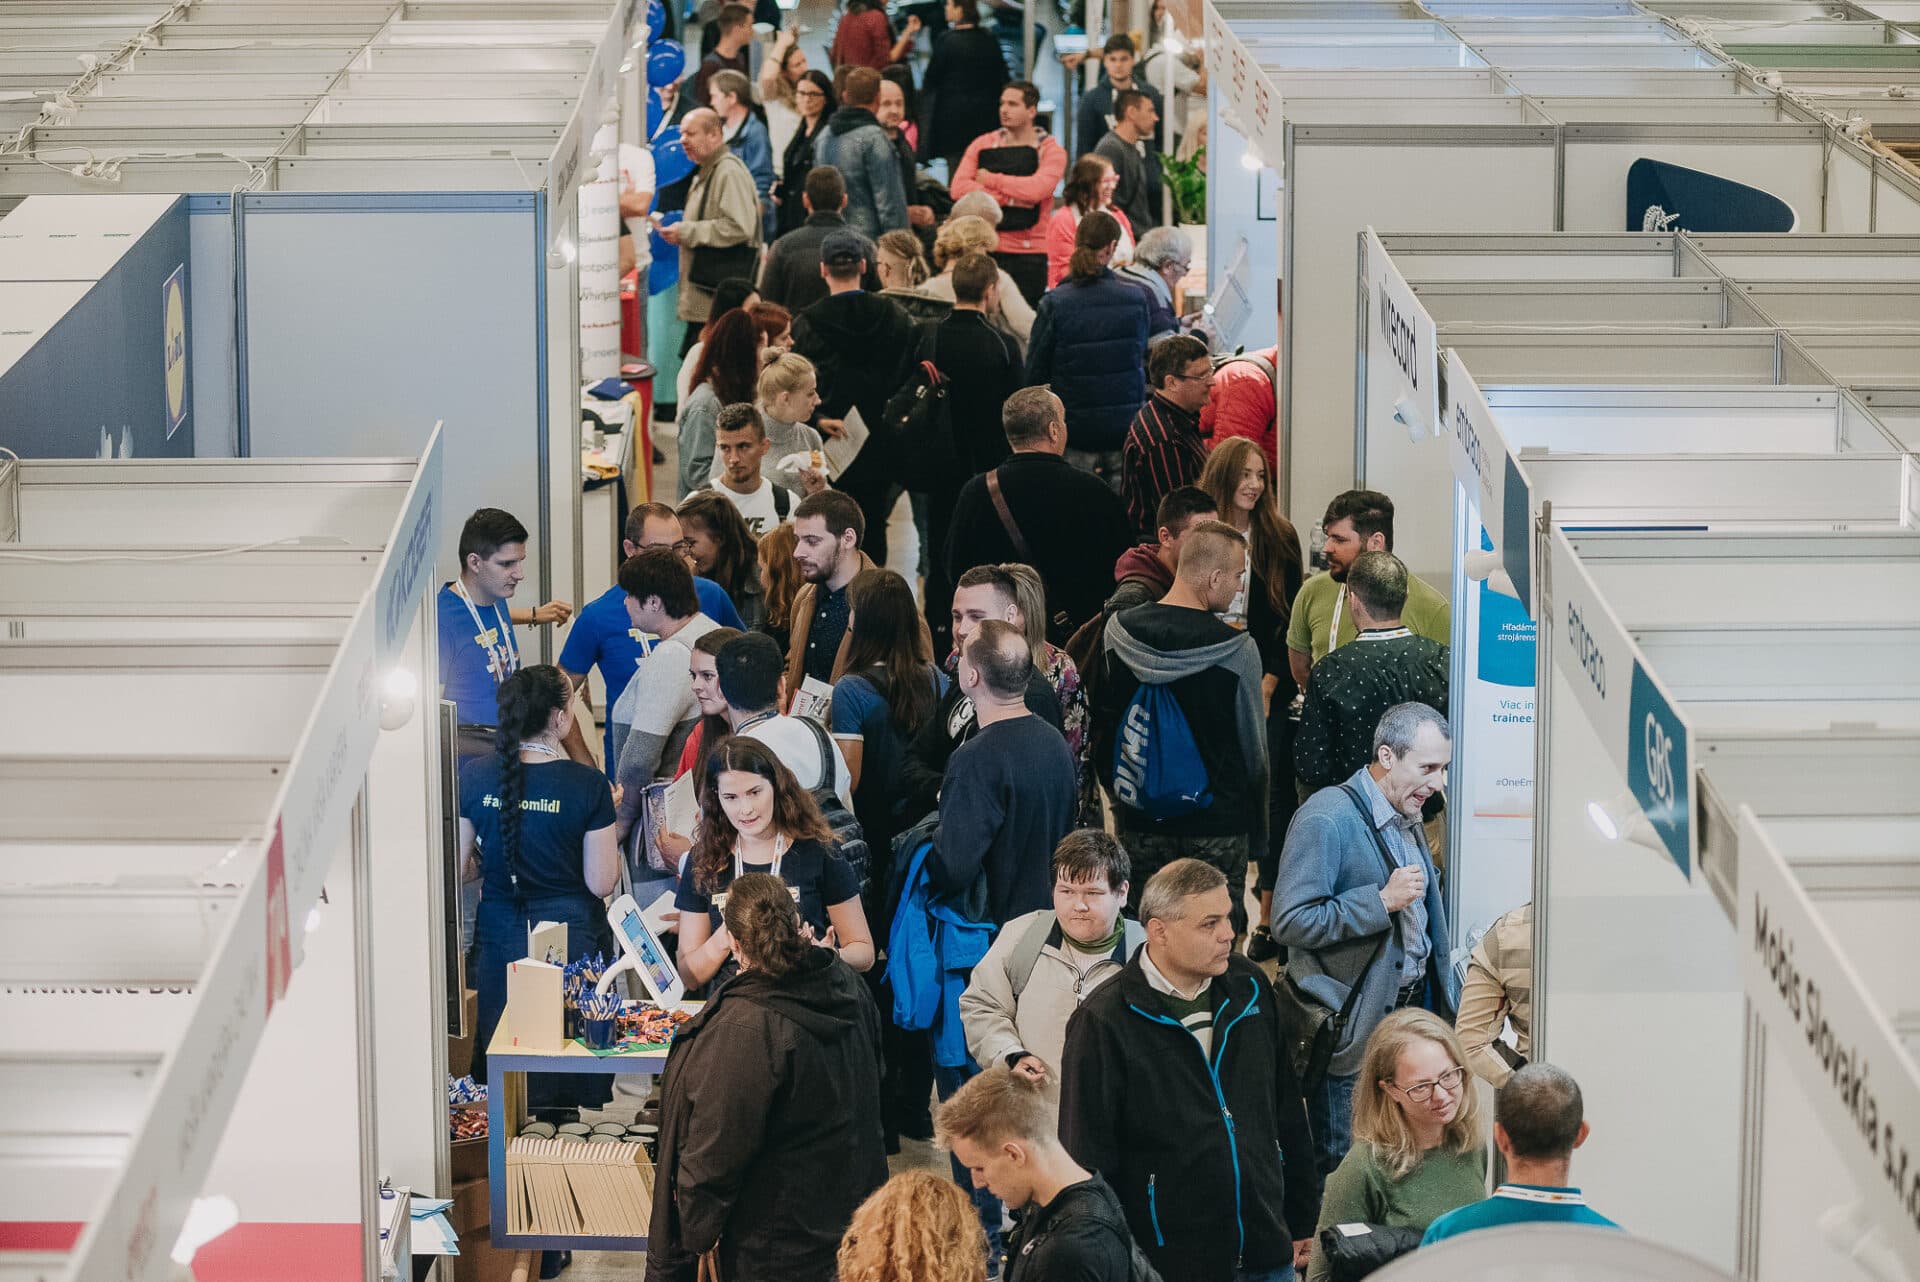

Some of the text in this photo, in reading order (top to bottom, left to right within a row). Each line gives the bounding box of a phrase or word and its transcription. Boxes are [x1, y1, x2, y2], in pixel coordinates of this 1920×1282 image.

[1379, 273, 1418, 392] wirecard
[1456, 401, 1481, 476] embraco
[1568, 600, 1606, 700] embraco
[1500, 700, 1521, 709] Viac
[1114, 704, 1150, 808] PUMA
[1645, 711, 1675, 812] GBS
[1754, 890, 1801, 1023] Mobis
[1805, 978, 1878, 1156] Slovakia
